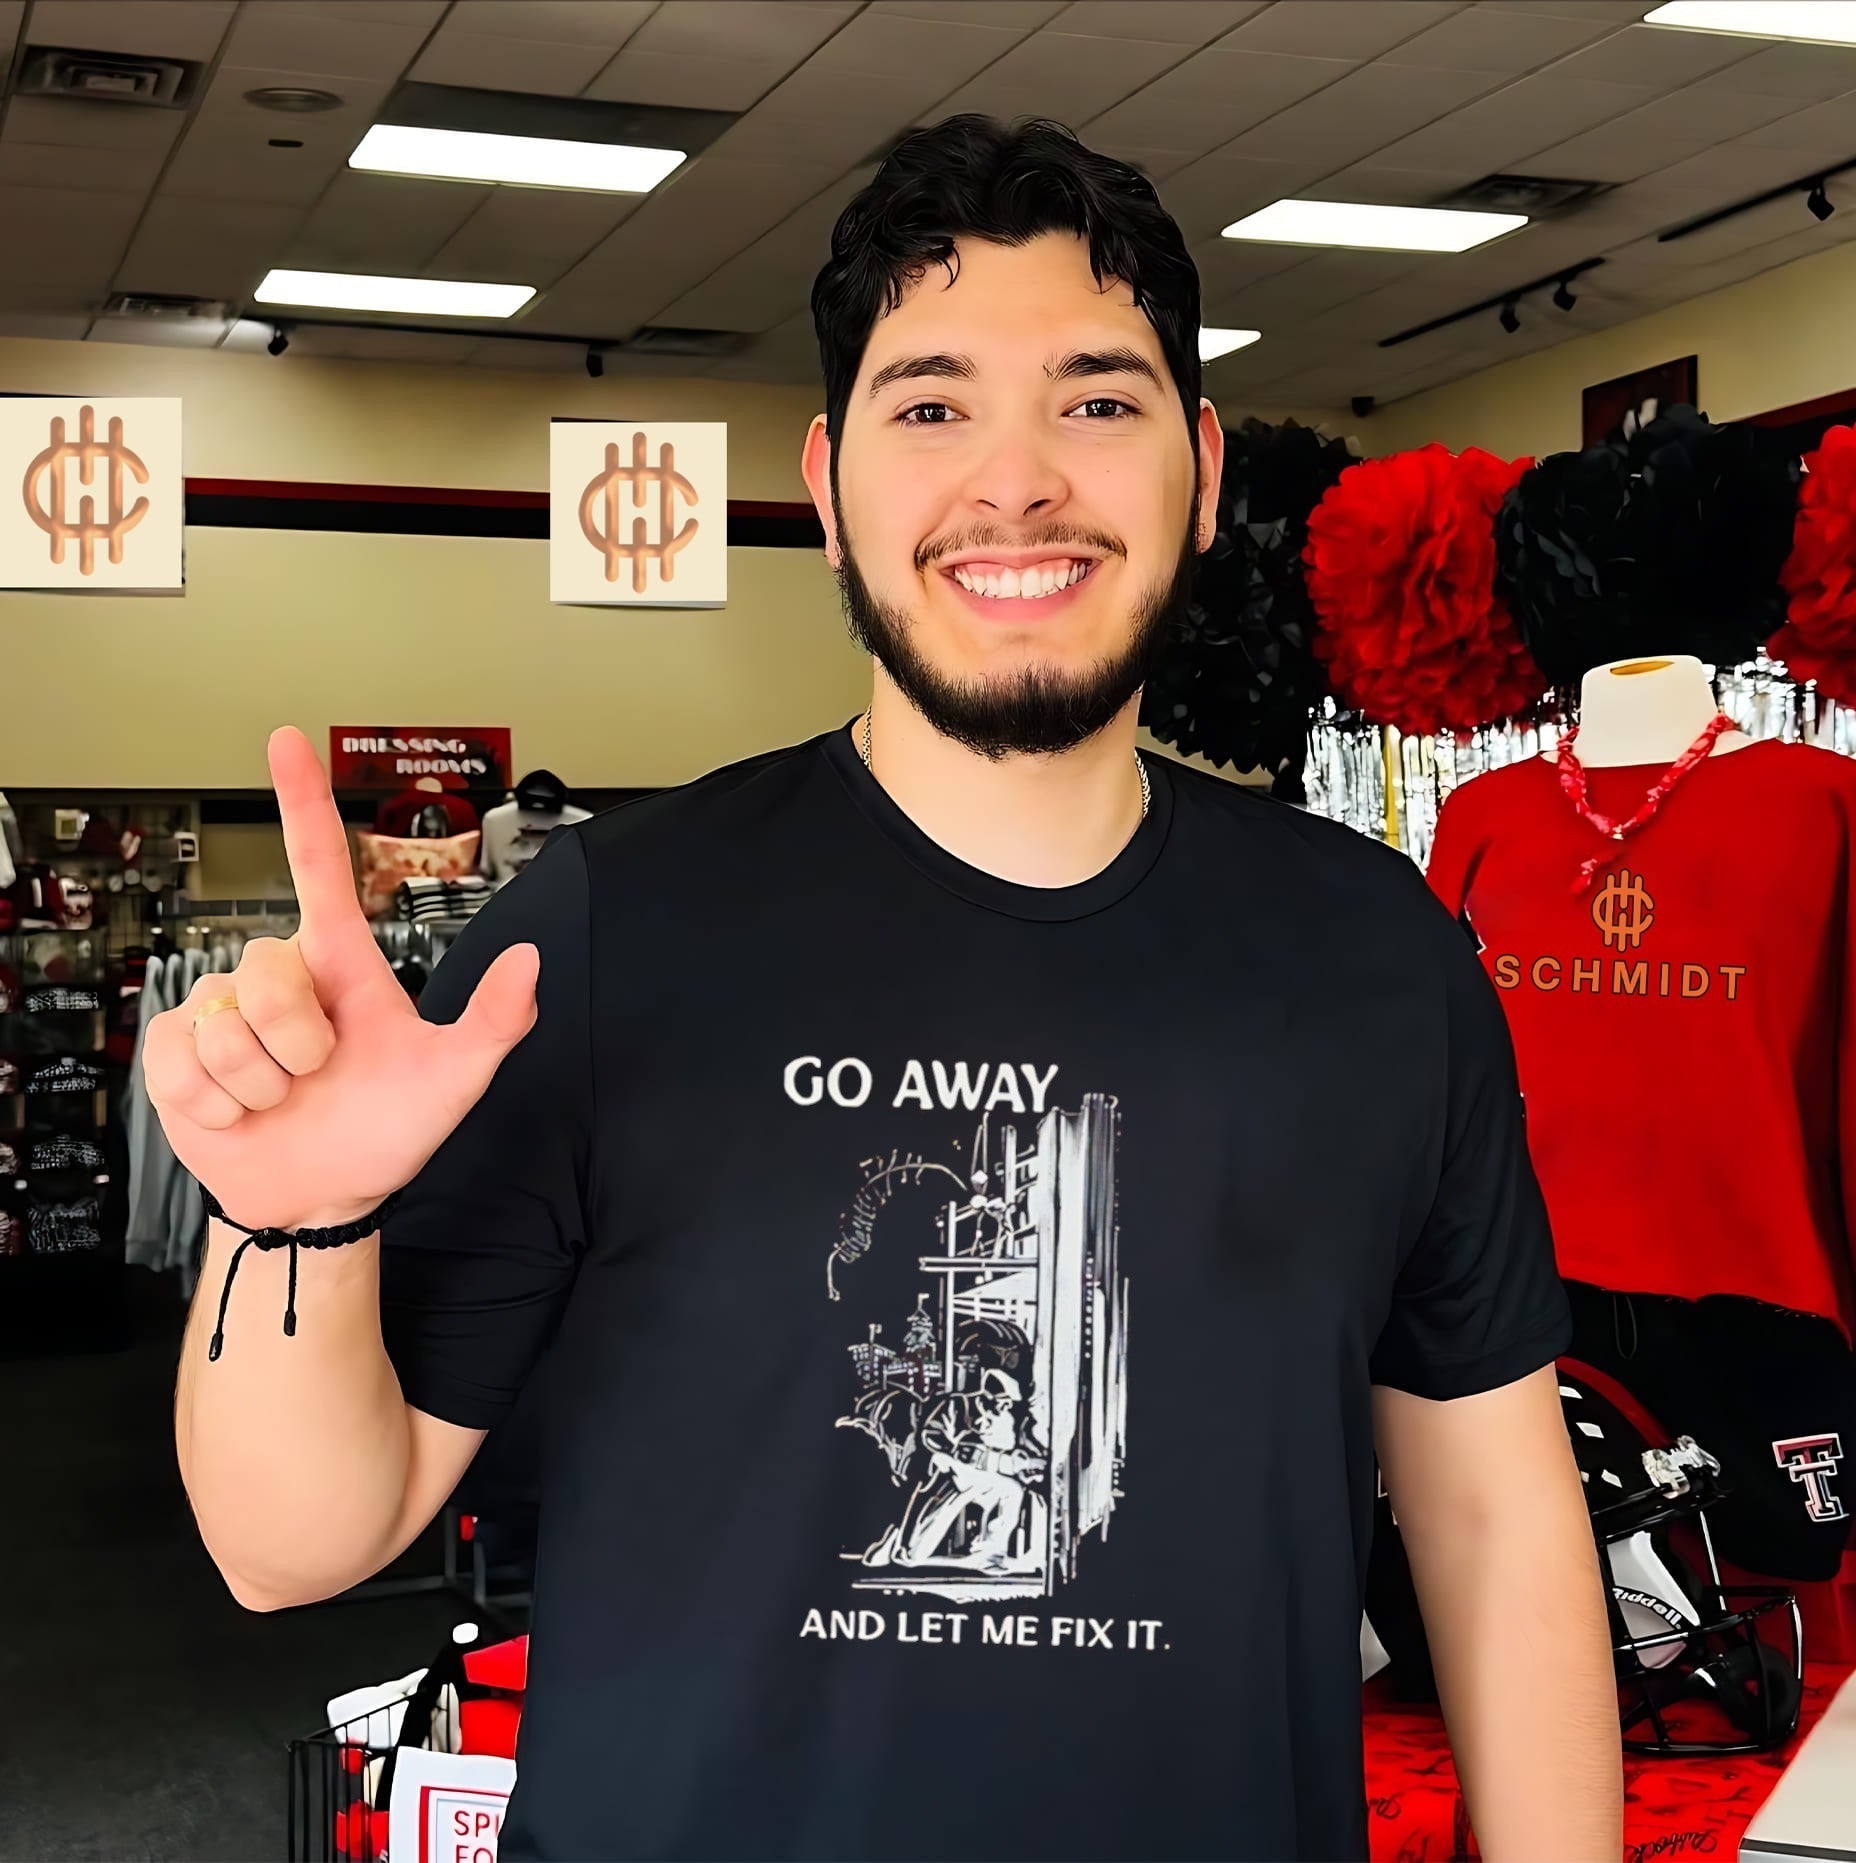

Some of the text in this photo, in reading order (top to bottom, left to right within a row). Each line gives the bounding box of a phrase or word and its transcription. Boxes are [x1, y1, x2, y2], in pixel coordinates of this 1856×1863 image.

[1494, 954, 1747, 1000] SCHMIDT
[783, 1055, 1059, 1113] GO AWAY
[799, 1608, 1171, 1651] AND LET ME FIX IT.
